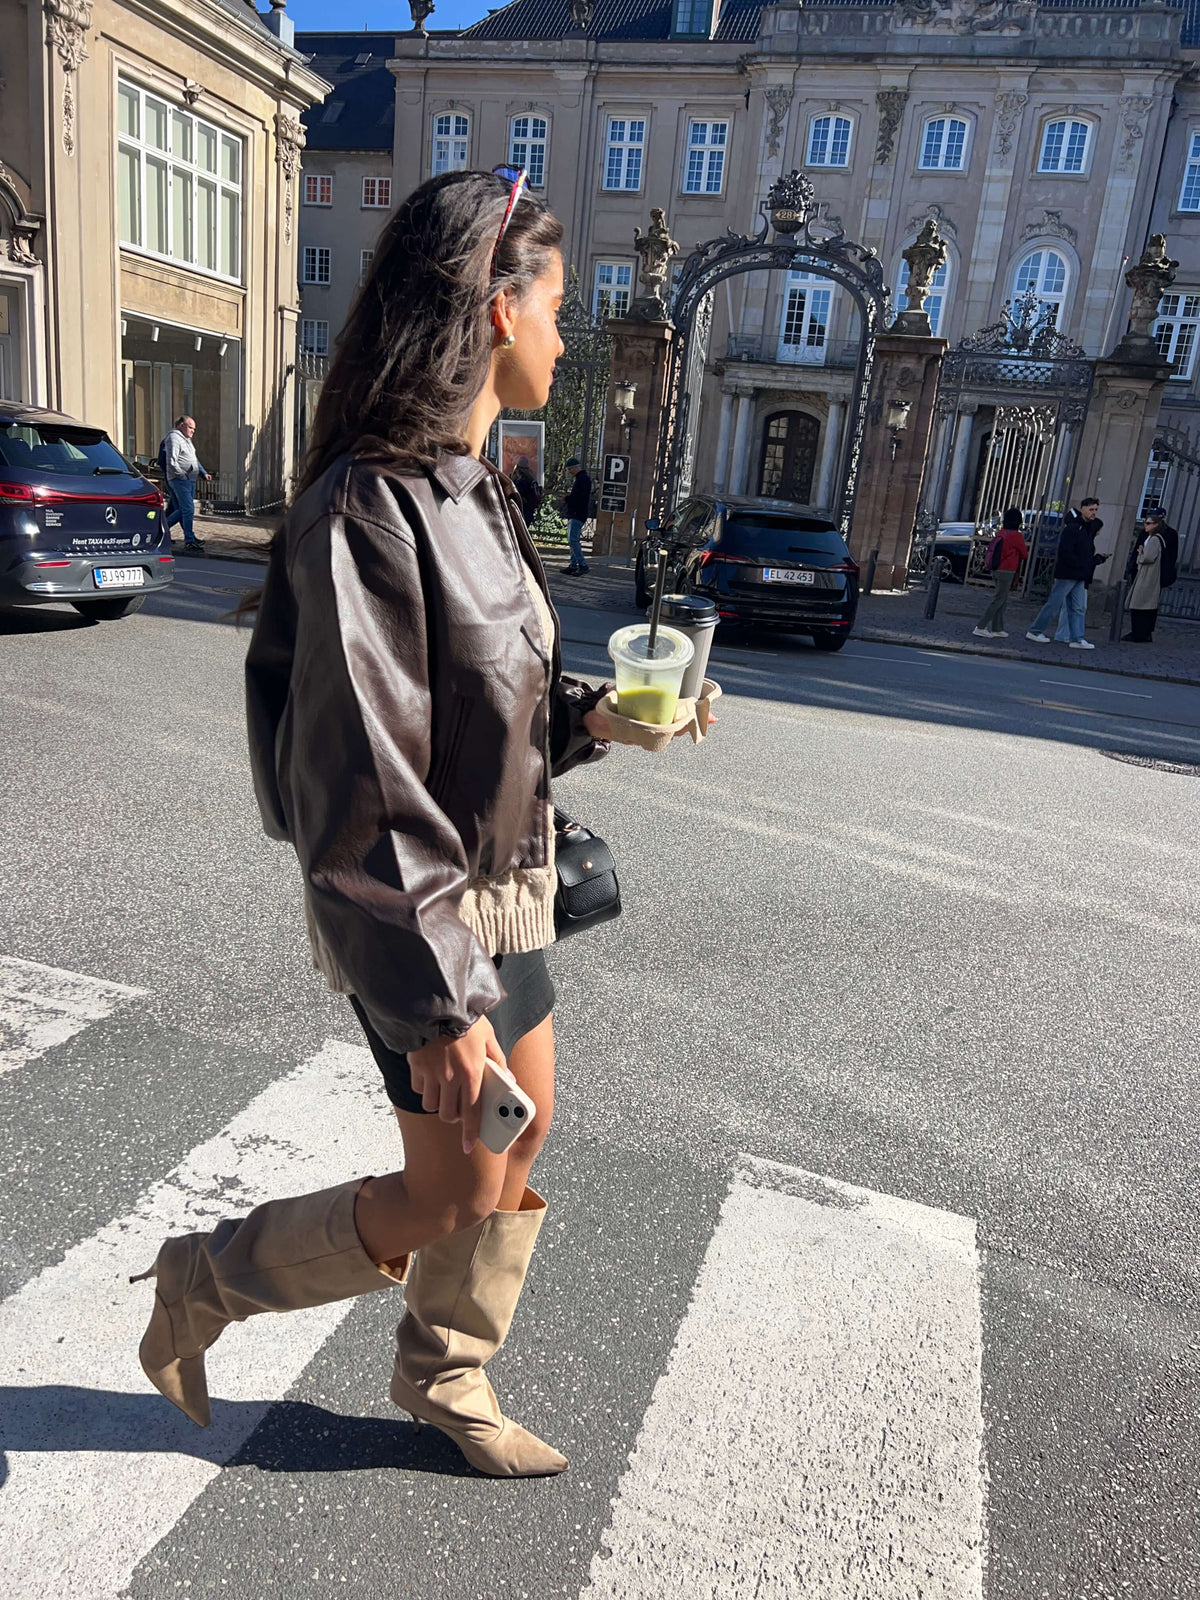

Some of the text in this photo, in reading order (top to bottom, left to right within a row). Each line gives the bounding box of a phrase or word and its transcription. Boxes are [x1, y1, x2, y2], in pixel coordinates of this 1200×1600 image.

[610, 457, 625, 480] P
[770, 570, 813, 582] EL 42 453
